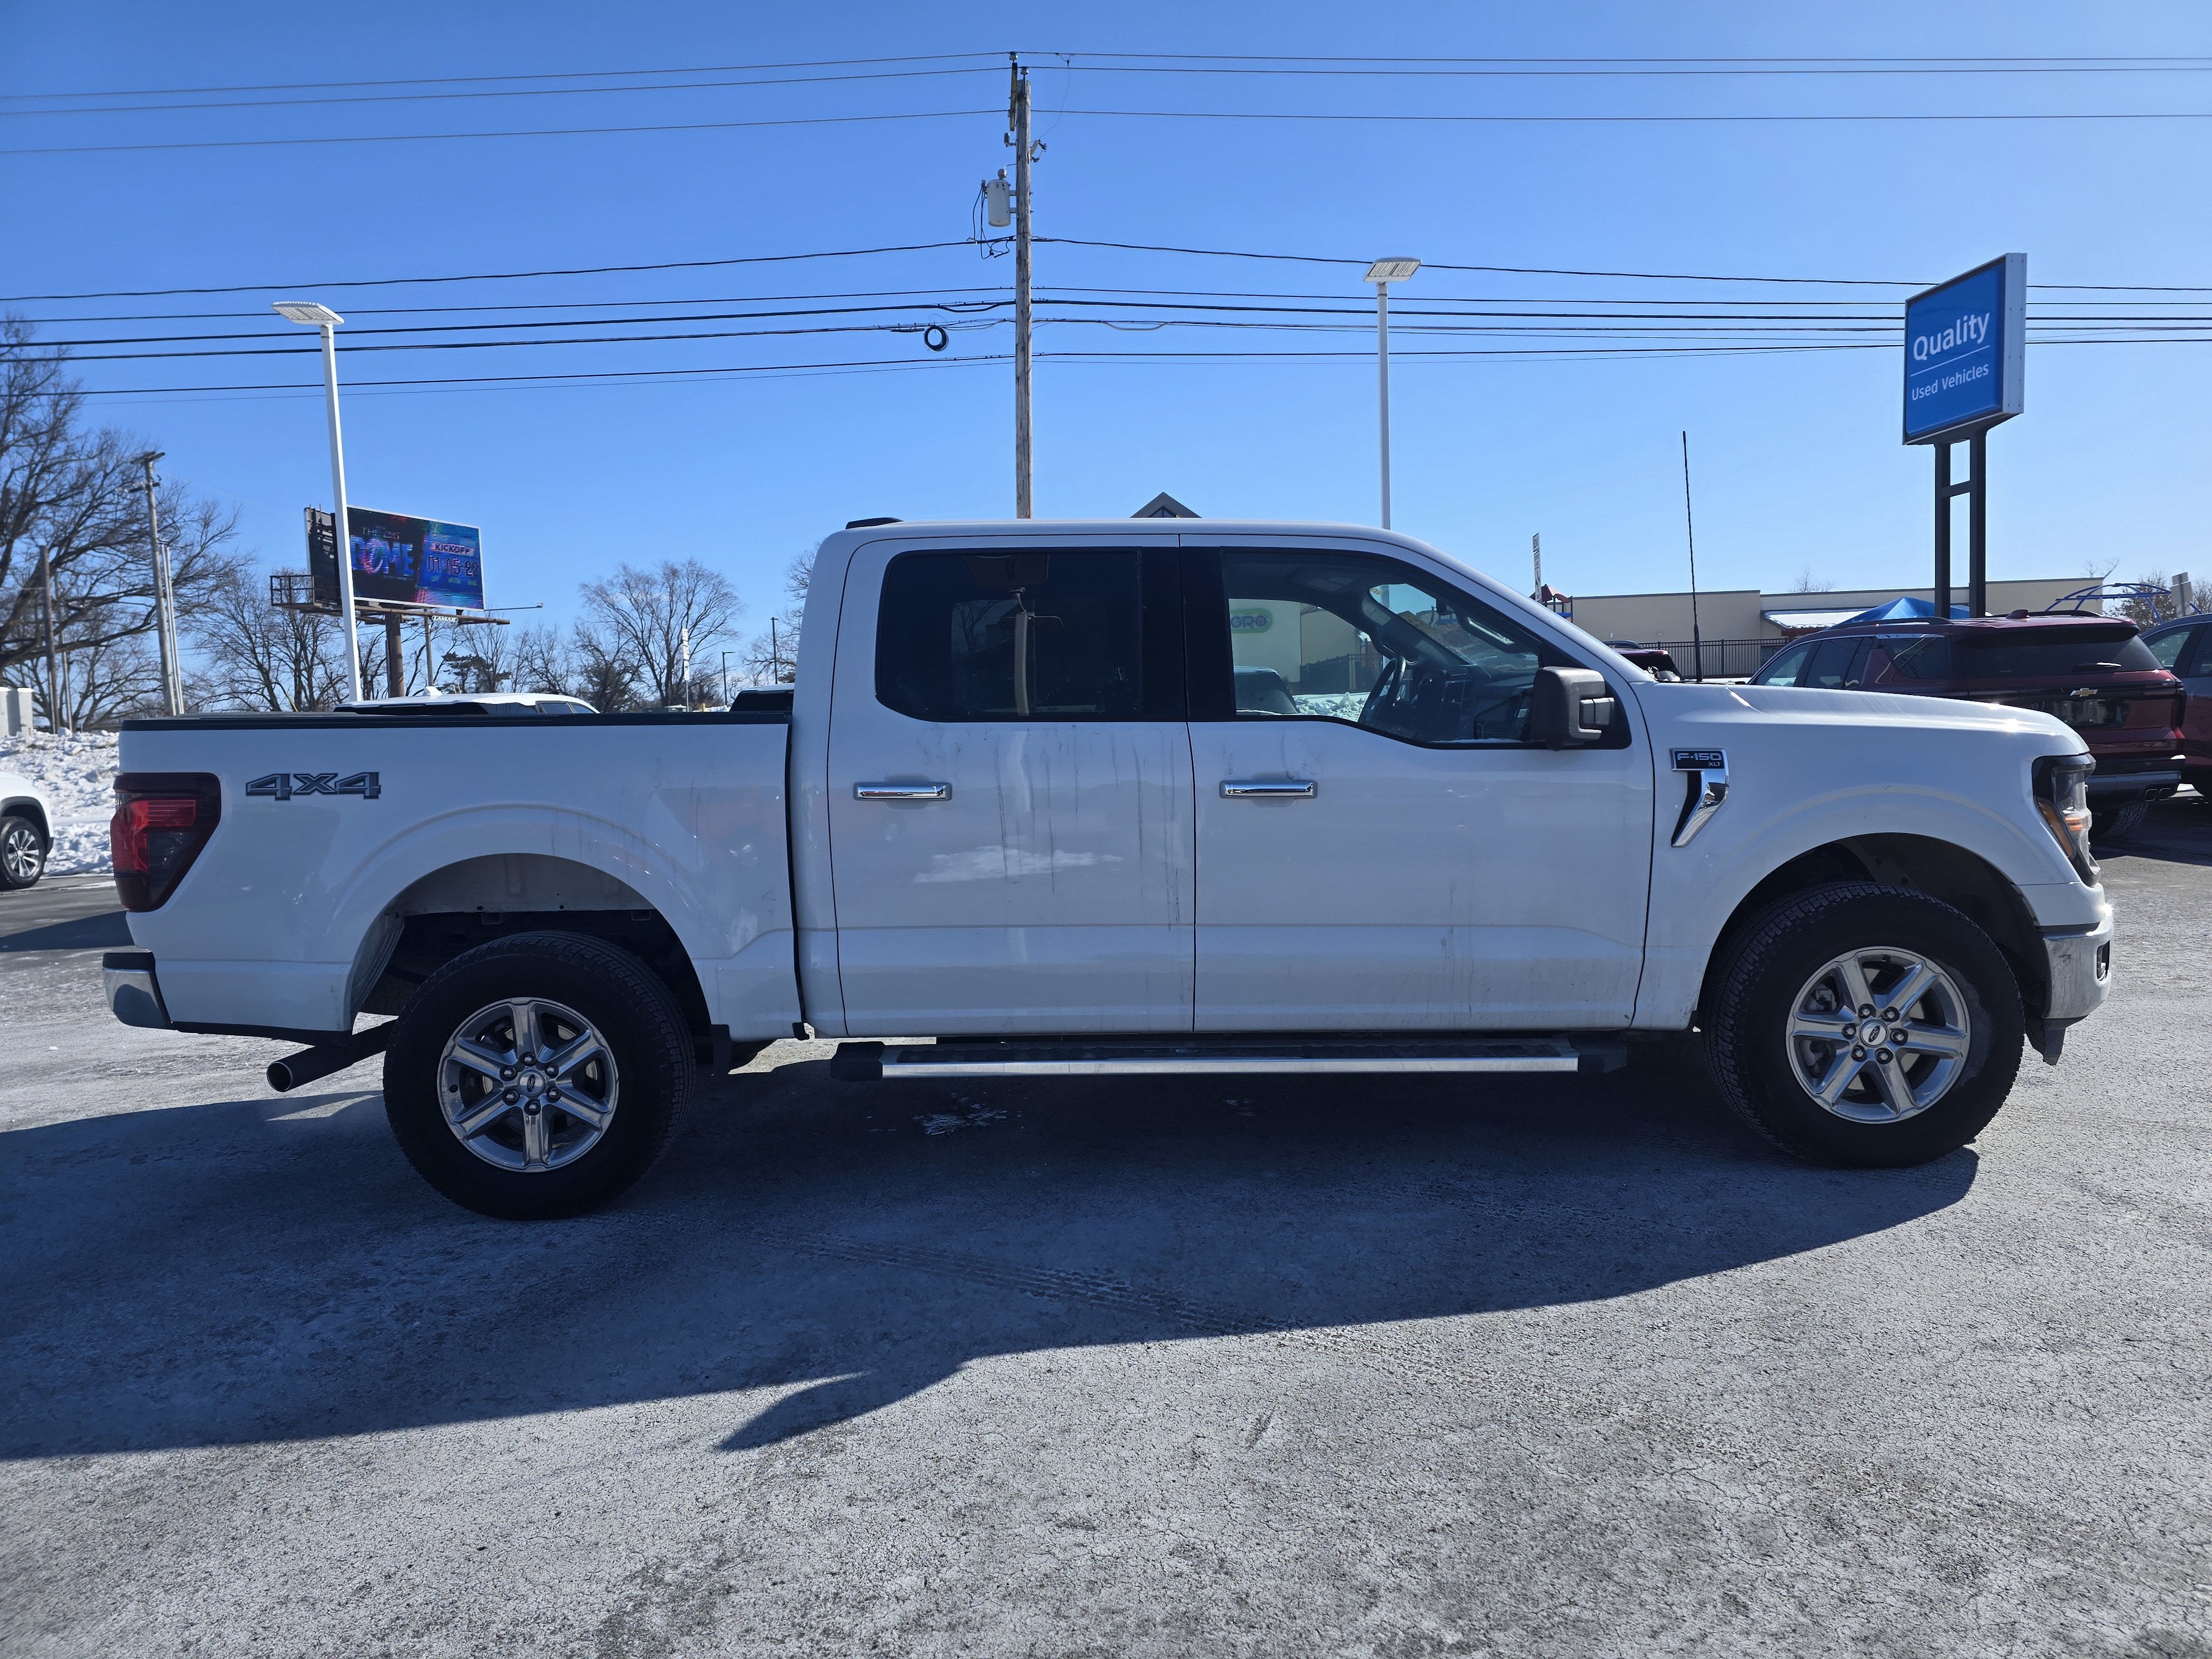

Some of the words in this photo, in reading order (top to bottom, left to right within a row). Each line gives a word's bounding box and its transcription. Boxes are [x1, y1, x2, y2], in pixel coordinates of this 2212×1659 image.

[1912, 312, 1990, 361] Quality
[1912, 379, 1938, 401] Used
[1942, 364, 1989, 390] Vehicles
[435, 543, 471, 554] KICKOFF
[1677, 753, 1722, 761] F-150
